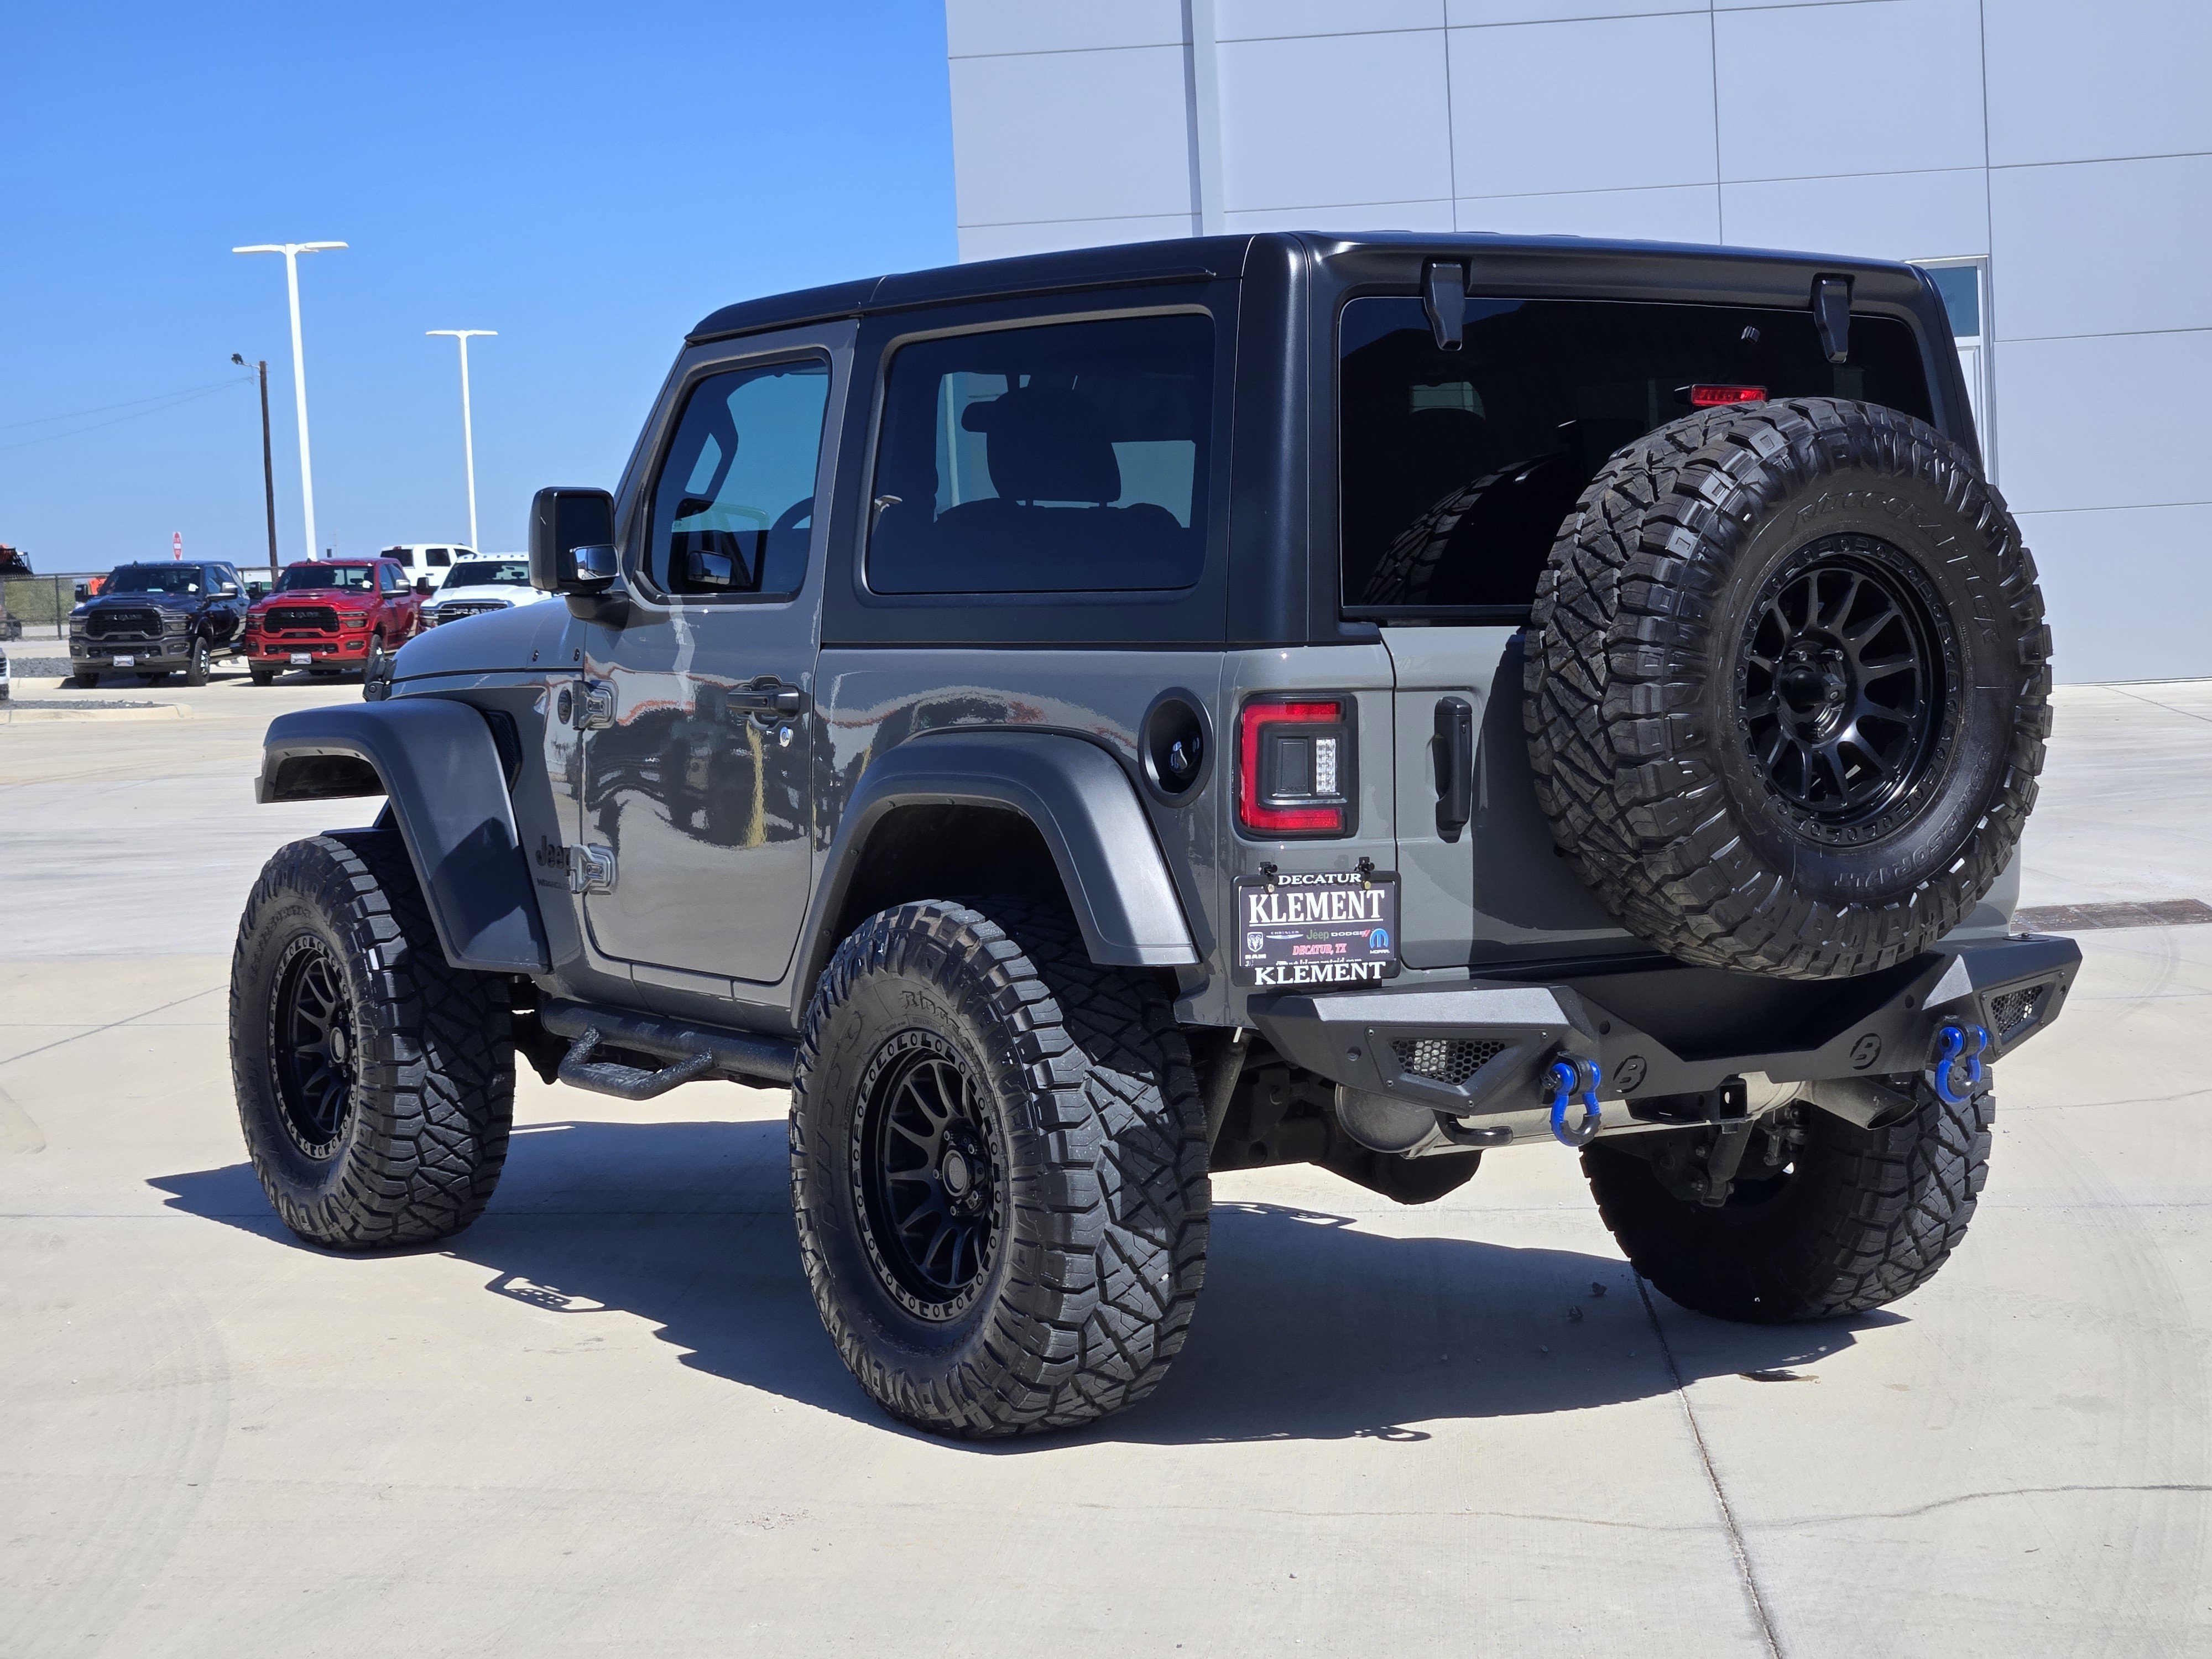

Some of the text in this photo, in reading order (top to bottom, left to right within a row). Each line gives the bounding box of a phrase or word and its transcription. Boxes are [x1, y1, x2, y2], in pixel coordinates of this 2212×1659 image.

[1278, 873, 1361, 885] DECATUR
[1248, 889, 1385, 924] KLEMENT
[1306, 929, 1329, 941] Jeep
[1292, 943, 1347, 956] DECATUR, TX
[1254, 961, 1386, 985] KLEMENT
